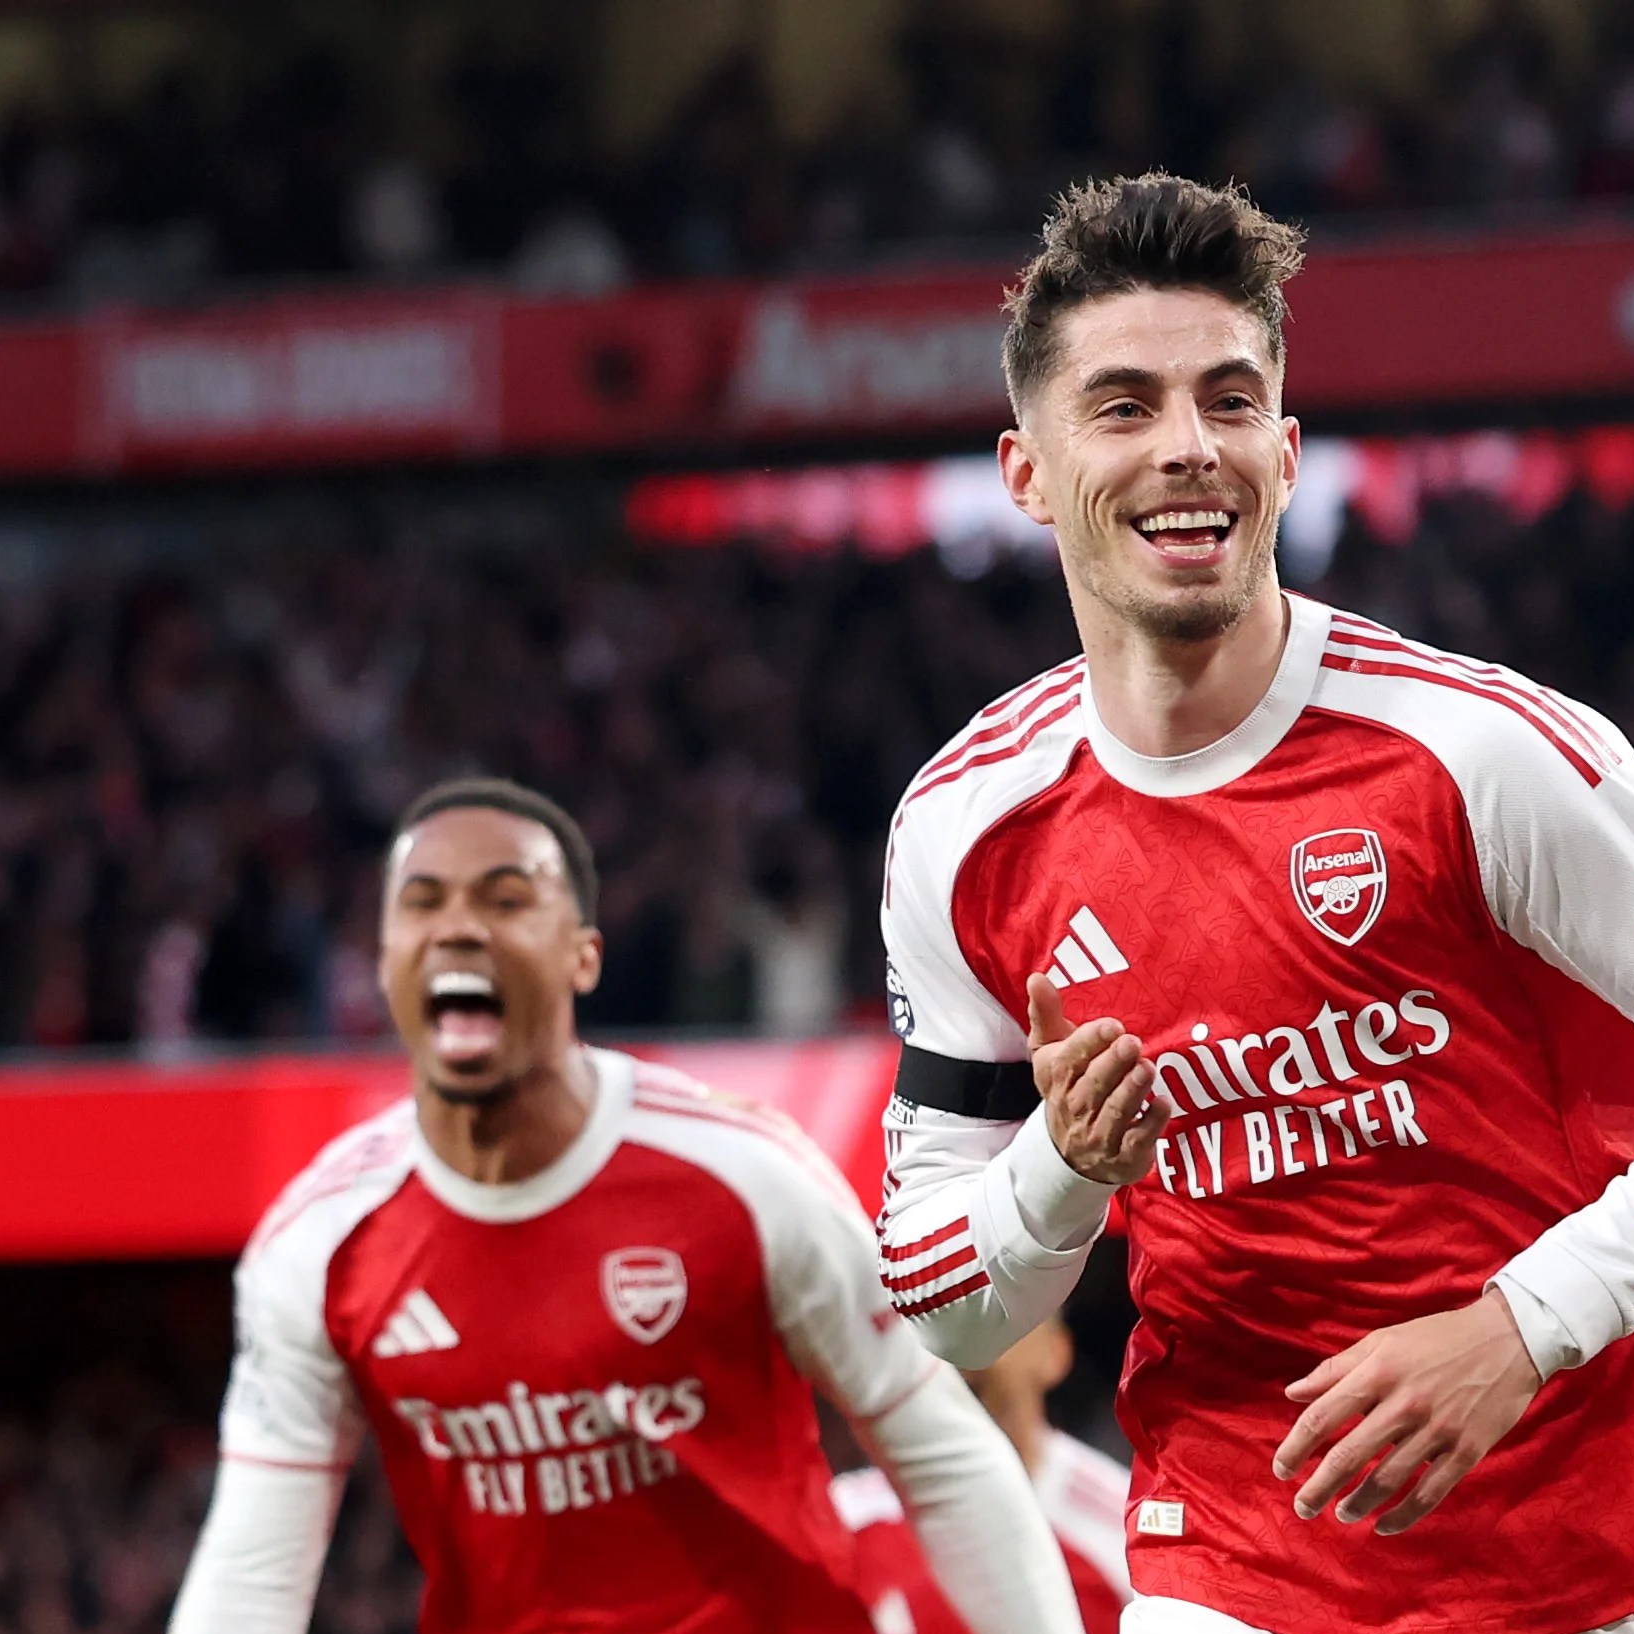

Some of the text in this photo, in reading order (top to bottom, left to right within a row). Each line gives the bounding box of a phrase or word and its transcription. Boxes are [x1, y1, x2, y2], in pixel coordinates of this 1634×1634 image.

[1304, 845, 1371, 873] Arsenal
[1134, 989, 1451, 1120] mirates
[1155, 1079, 1428, 1200] FLY BETTER
[394, 1378, 706, 1460] Emirates
[465, 1460, 526, 1516] FLY
